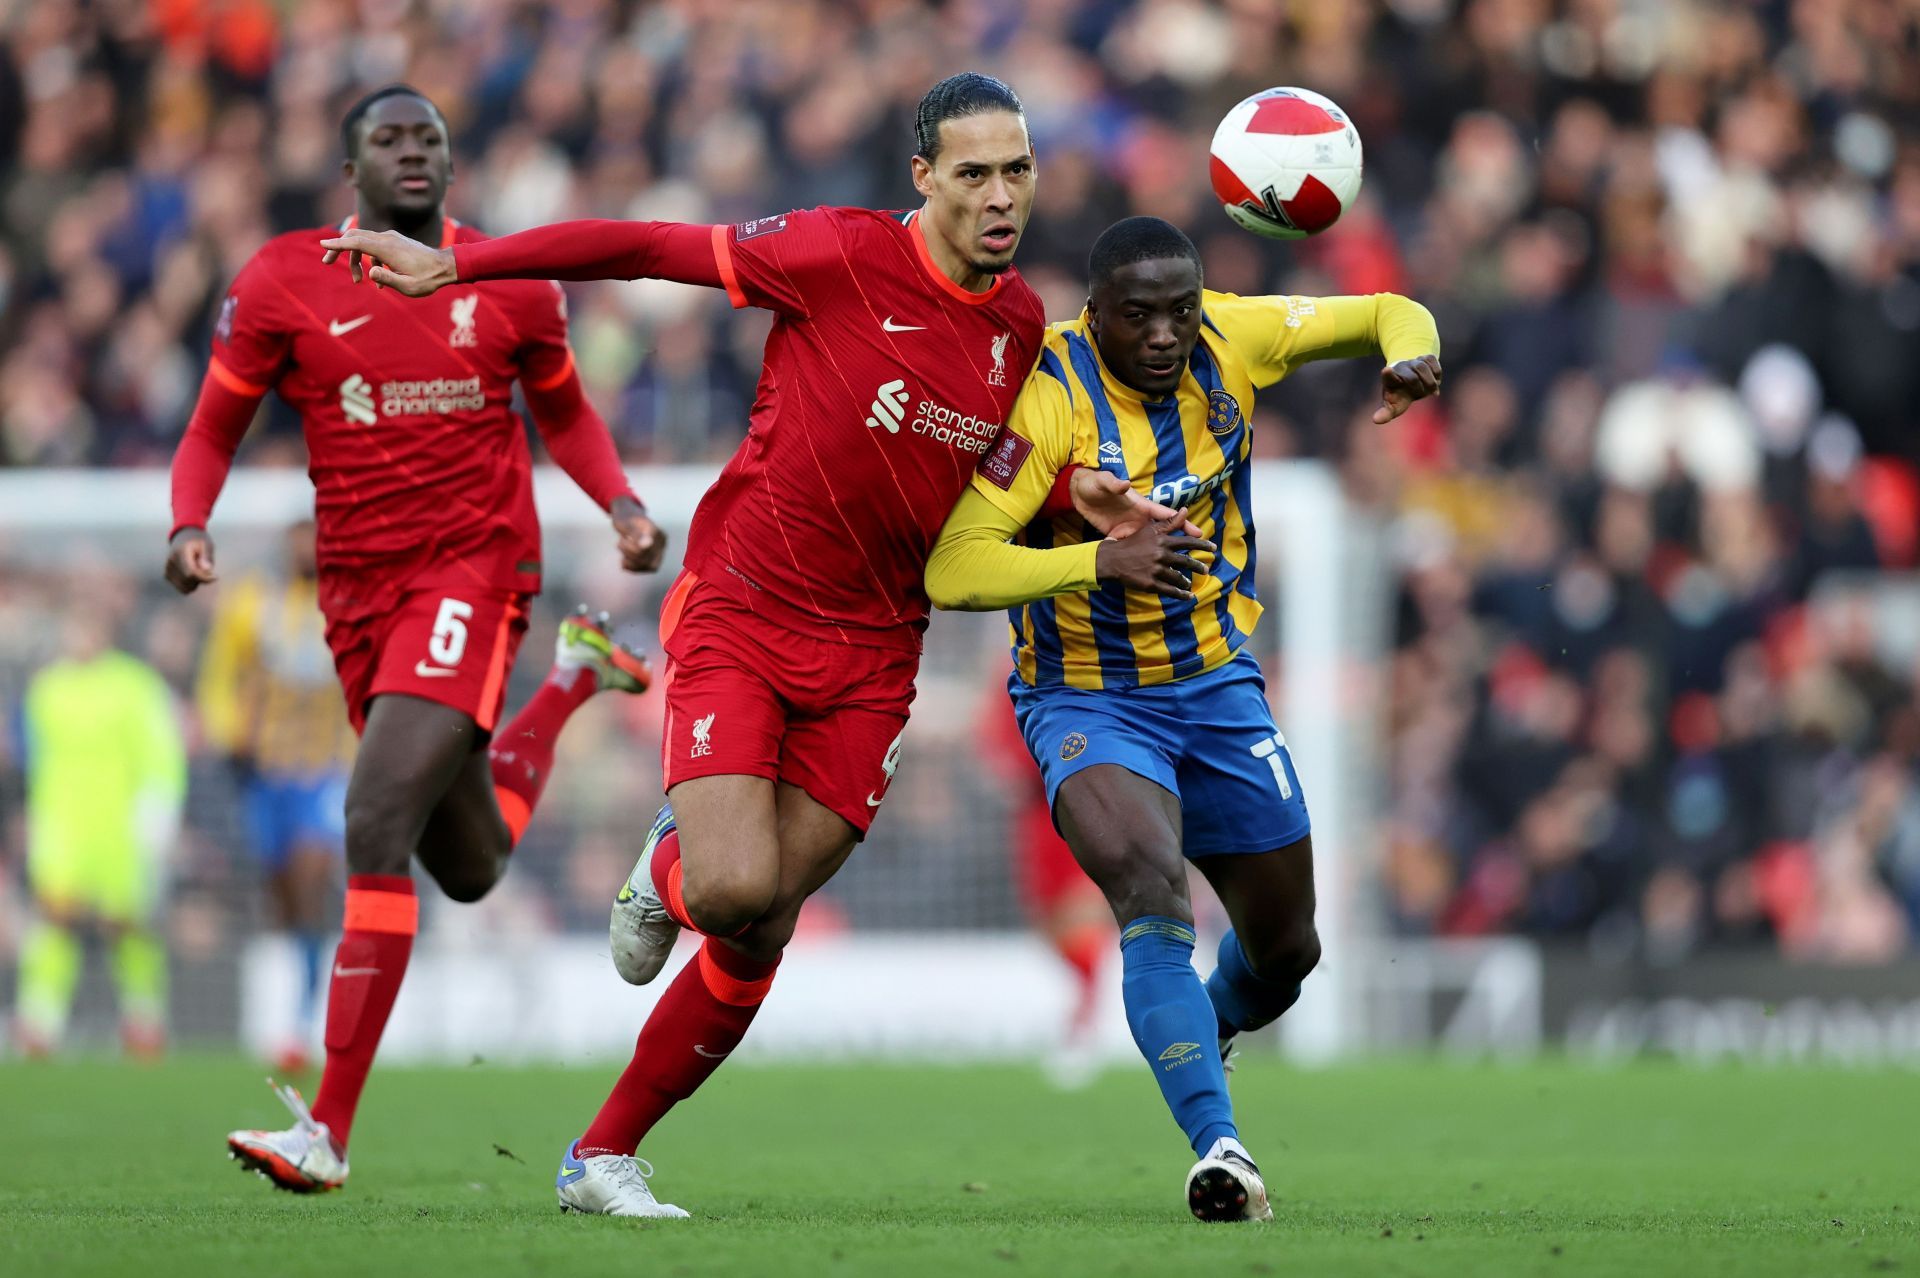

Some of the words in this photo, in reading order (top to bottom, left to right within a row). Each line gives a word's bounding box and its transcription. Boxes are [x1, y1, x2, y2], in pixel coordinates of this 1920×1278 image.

[381, 375, 480, 397] standard
[381, 392, 485, 417] chartered
[917, 400, 1001, 439] standard
[911, 418, 992, 454] chartere
[993, 464, 1010, 478] CUP
[428, 597, 474, 667] 5
[1165, 1053, 1203, 1072] umbro
